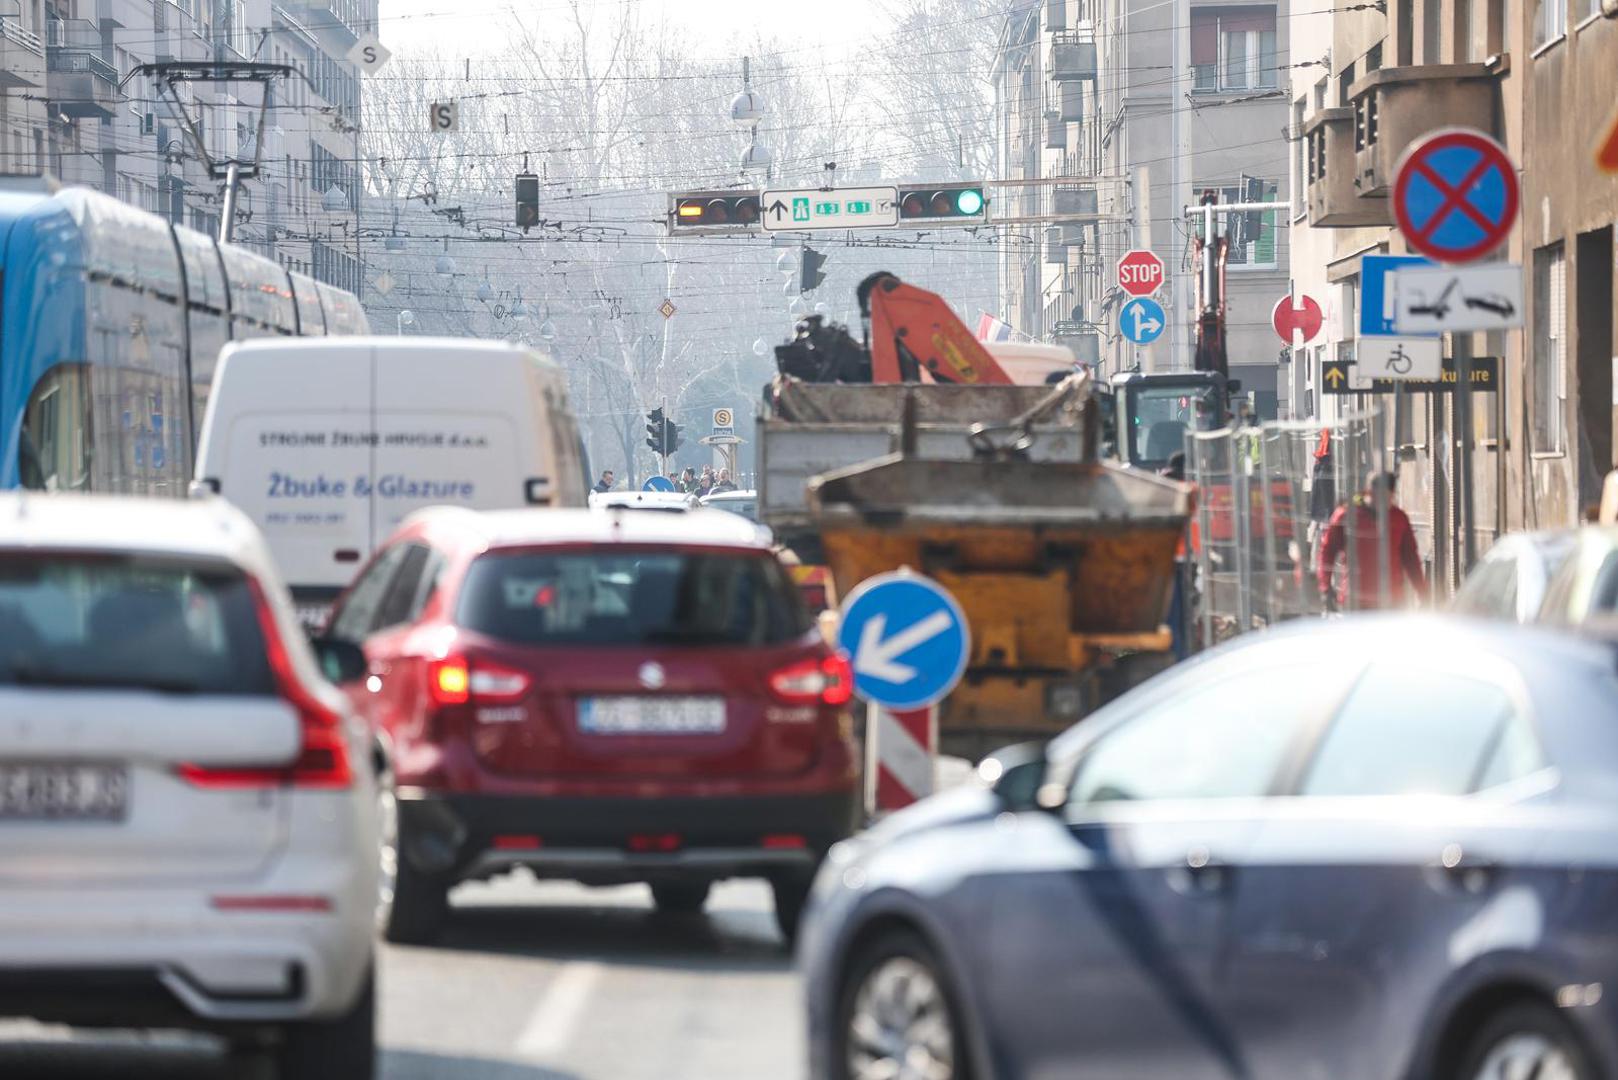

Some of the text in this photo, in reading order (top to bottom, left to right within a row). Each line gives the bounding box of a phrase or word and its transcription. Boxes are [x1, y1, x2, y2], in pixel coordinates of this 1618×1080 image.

[363, 46, 377, 63] S
[437, 106, 451, 128] S
[1121, 264, 1160, 283] STOP
[719, 412, 727, 423] S
[267, 471, 474, 498] Žbuke & Glazure
